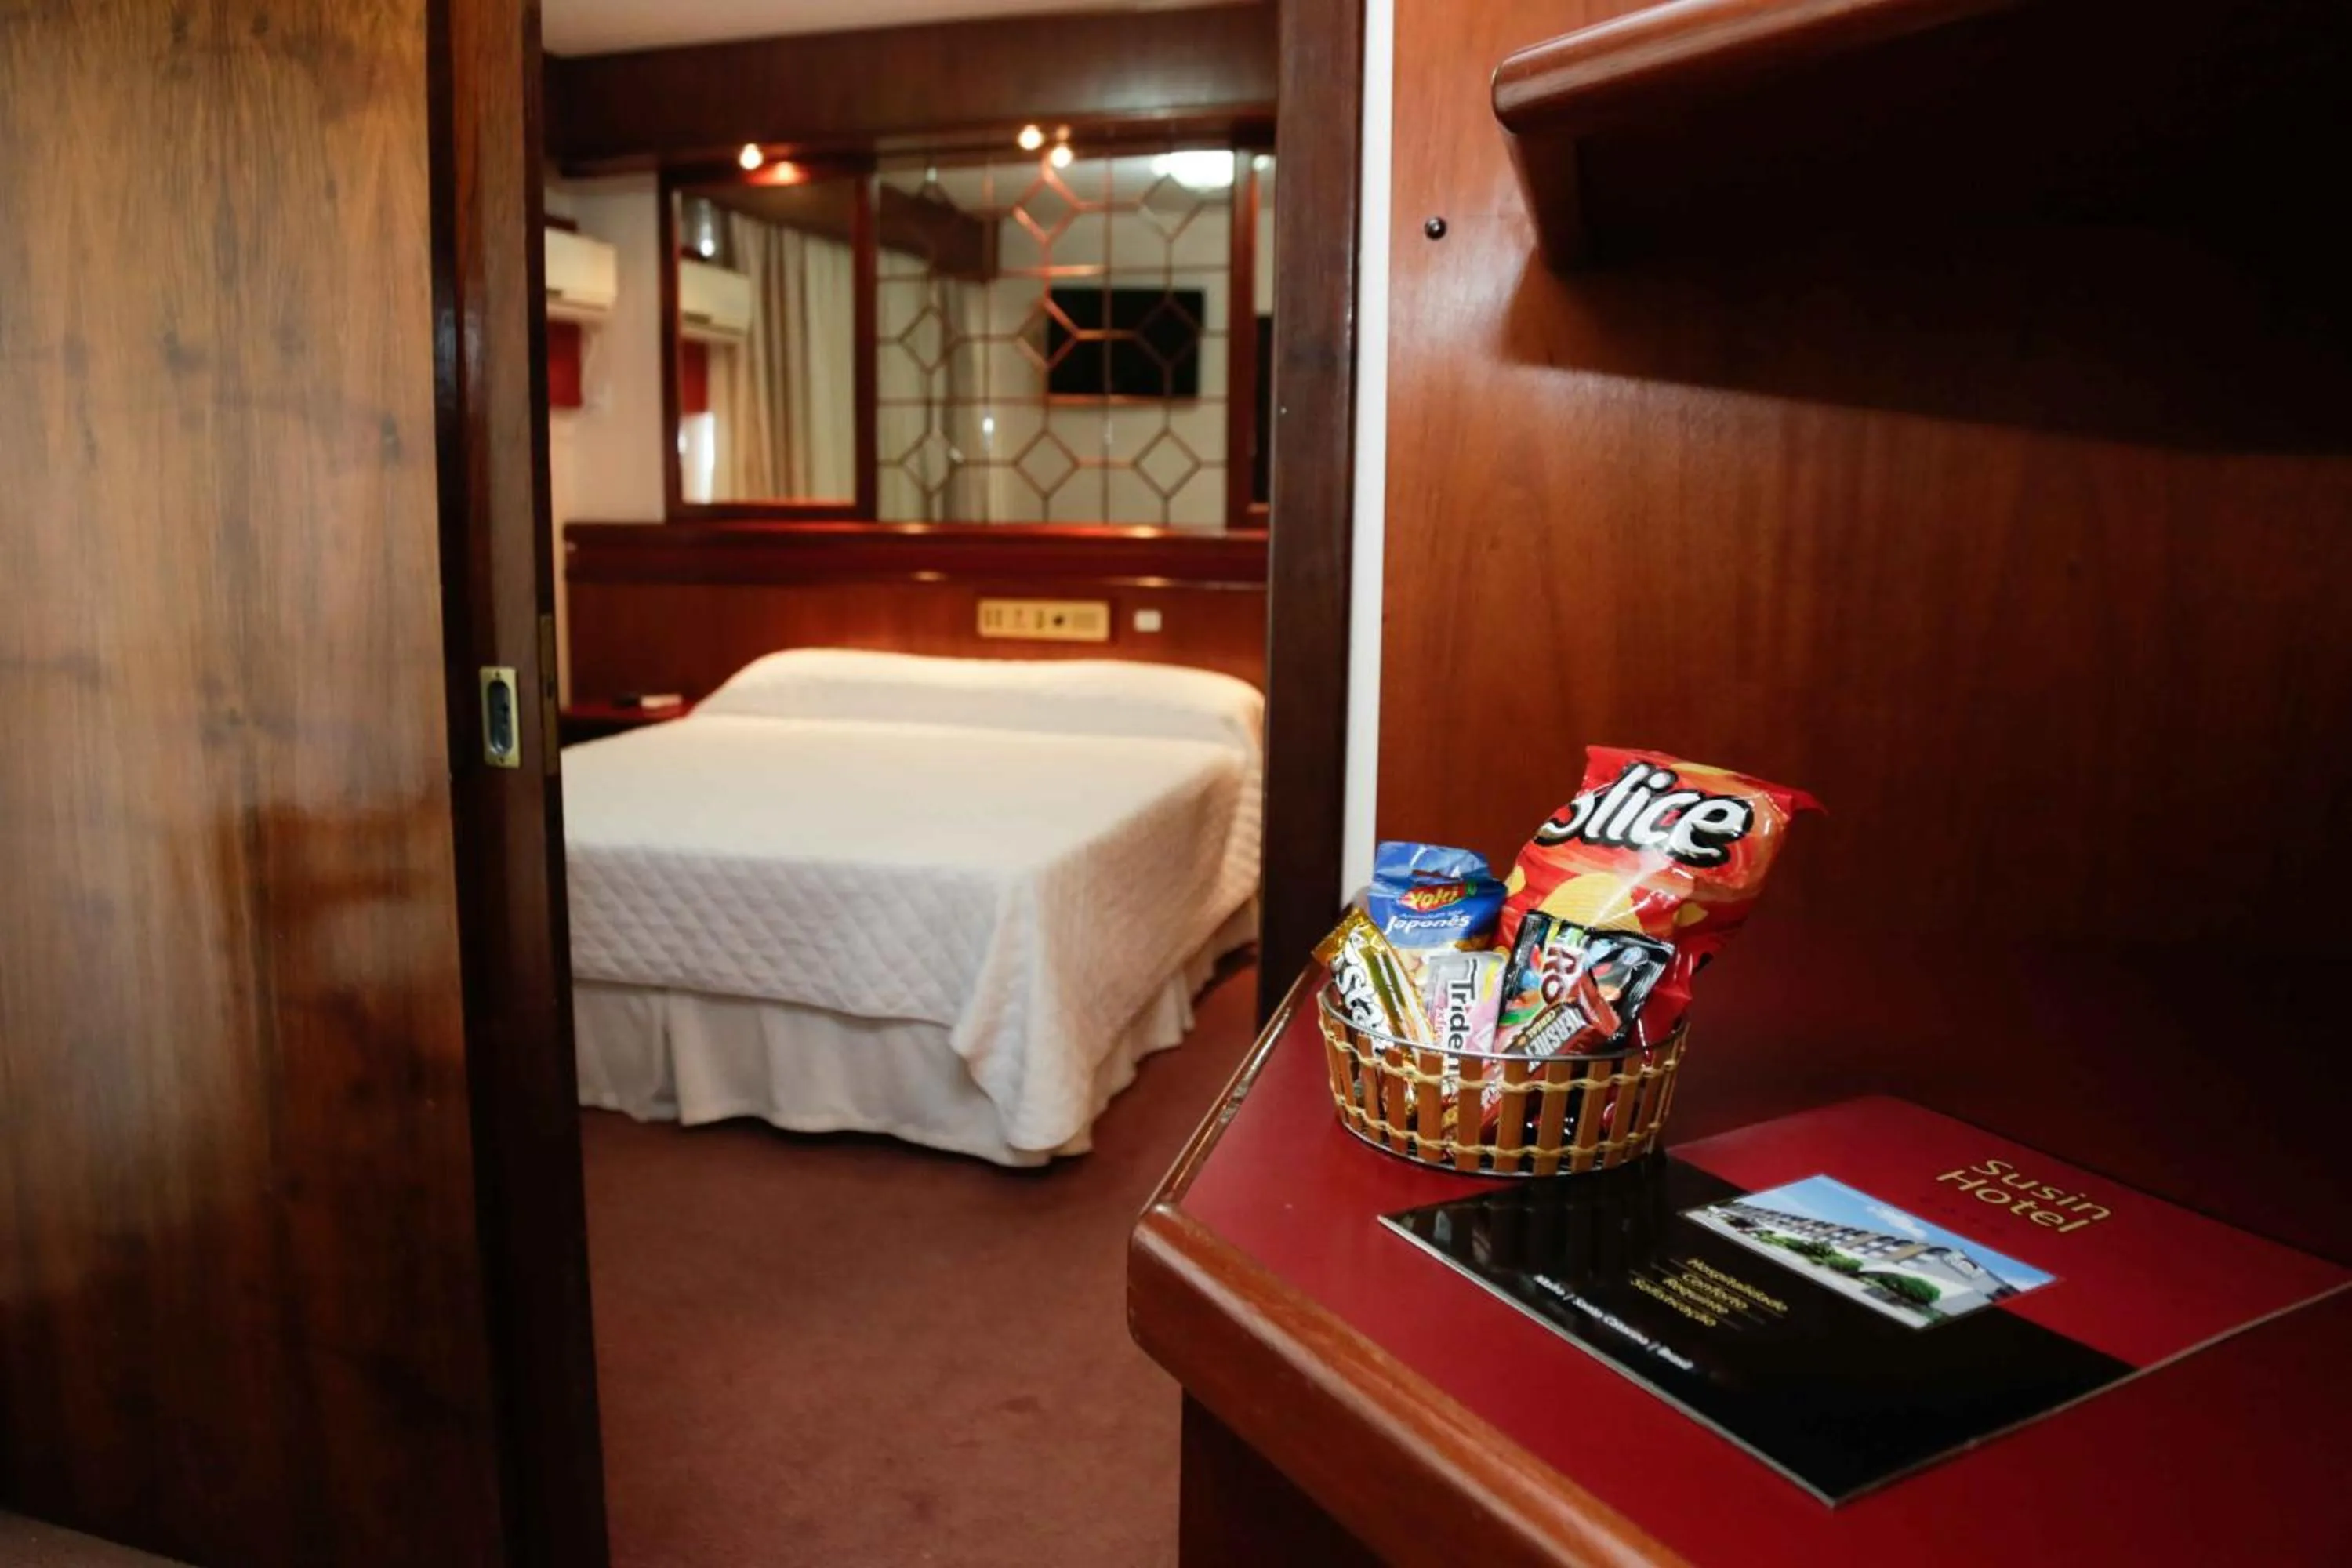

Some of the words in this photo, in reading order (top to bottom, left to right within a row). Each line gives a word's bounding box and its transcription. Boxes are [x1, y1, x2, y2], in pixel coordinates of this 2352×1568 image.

[1409, 884, 1460, 908] Yoki
[1385, 914, 1472, 935] Japonês
[1936, 1169, 2090, 1232] Hotel
[1969, 1159, 2111, 1220] Susin
